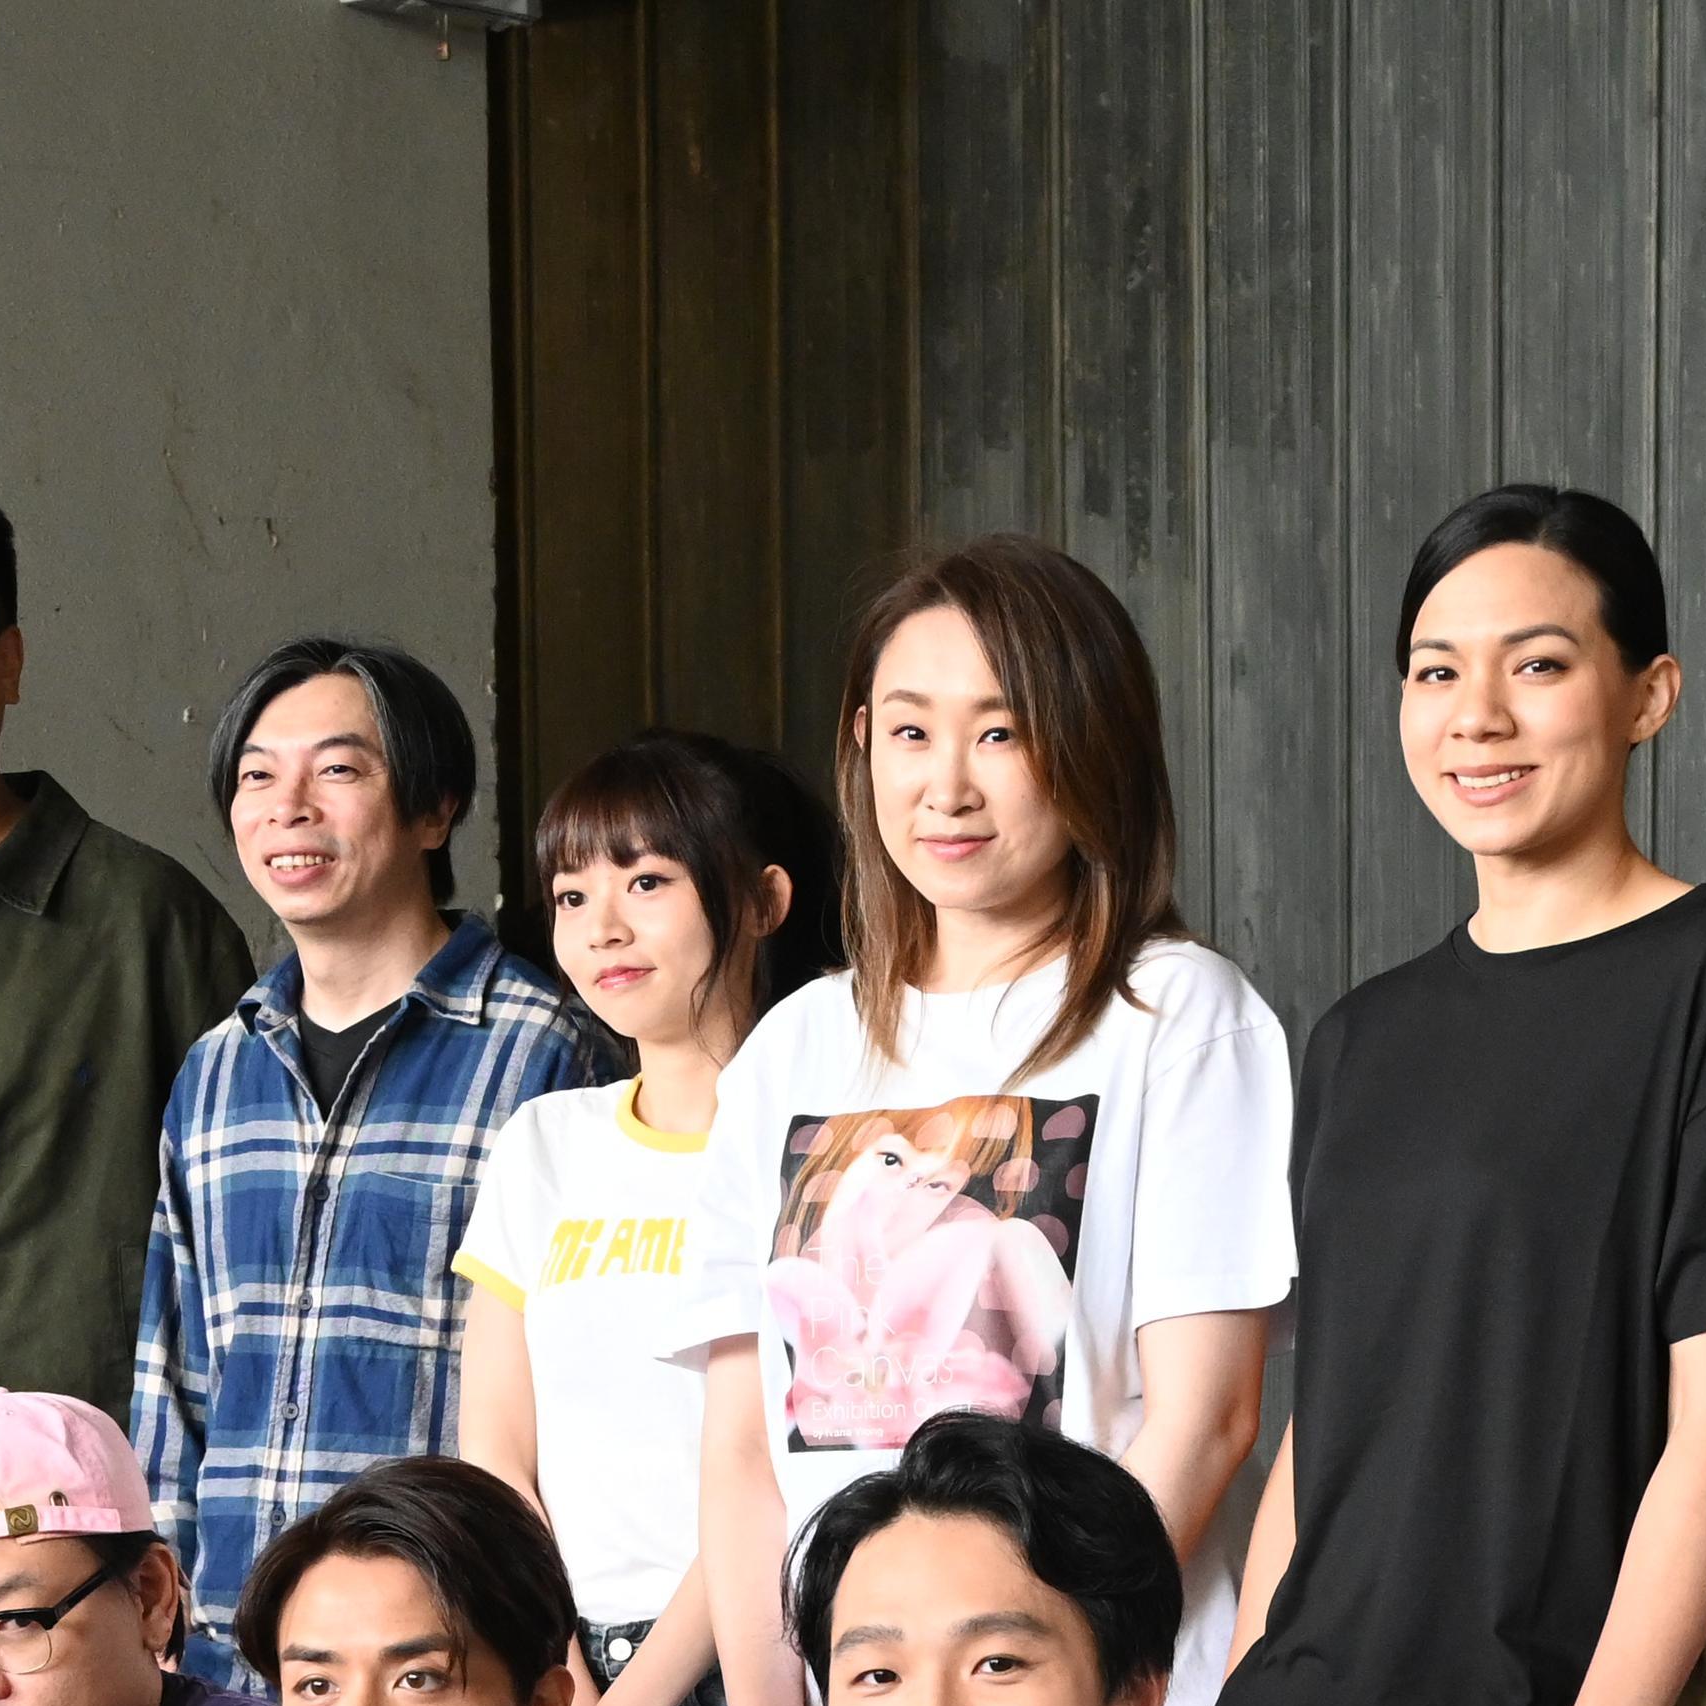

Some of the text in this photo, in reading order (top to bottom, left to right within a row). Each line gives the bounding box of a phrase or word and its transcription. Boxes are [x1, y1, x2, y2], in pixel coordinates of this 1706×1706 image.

[808, 1246, 887, 1287] The
[809, 1292, 897, 1339] Pink
[812, 1347, 954, 1389] Canvas
[812, 1399, 907, 1421] Exhibition
